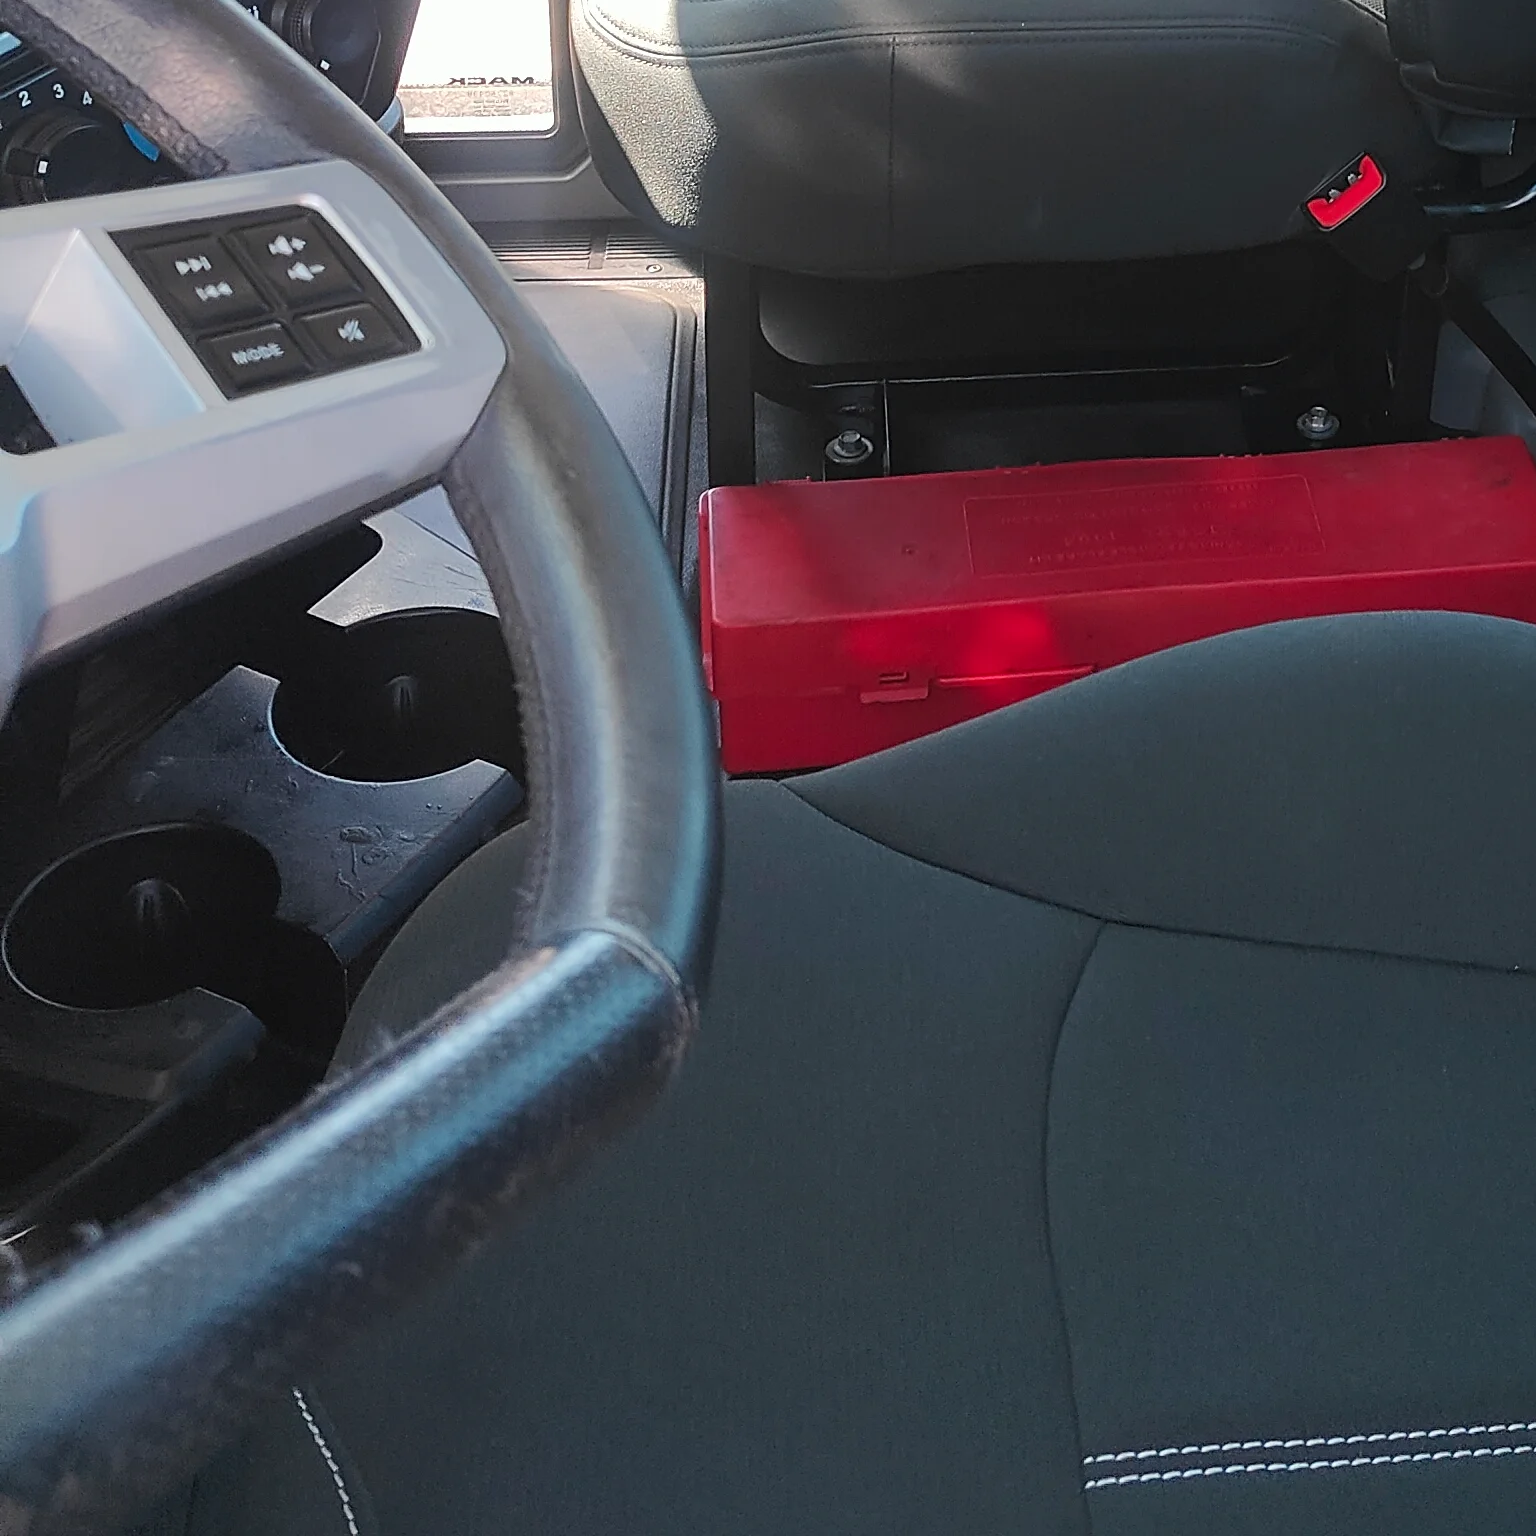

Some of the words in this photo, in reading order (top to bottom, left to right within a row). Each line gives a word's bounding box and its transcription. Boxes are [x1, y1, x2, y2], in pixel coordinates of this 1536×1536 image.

[18, 90, 32, 107] 2
[52, 83, 65, 99] 3
[82, 90, 93, 106] 4
[231, 342, 285, 365] MODE
